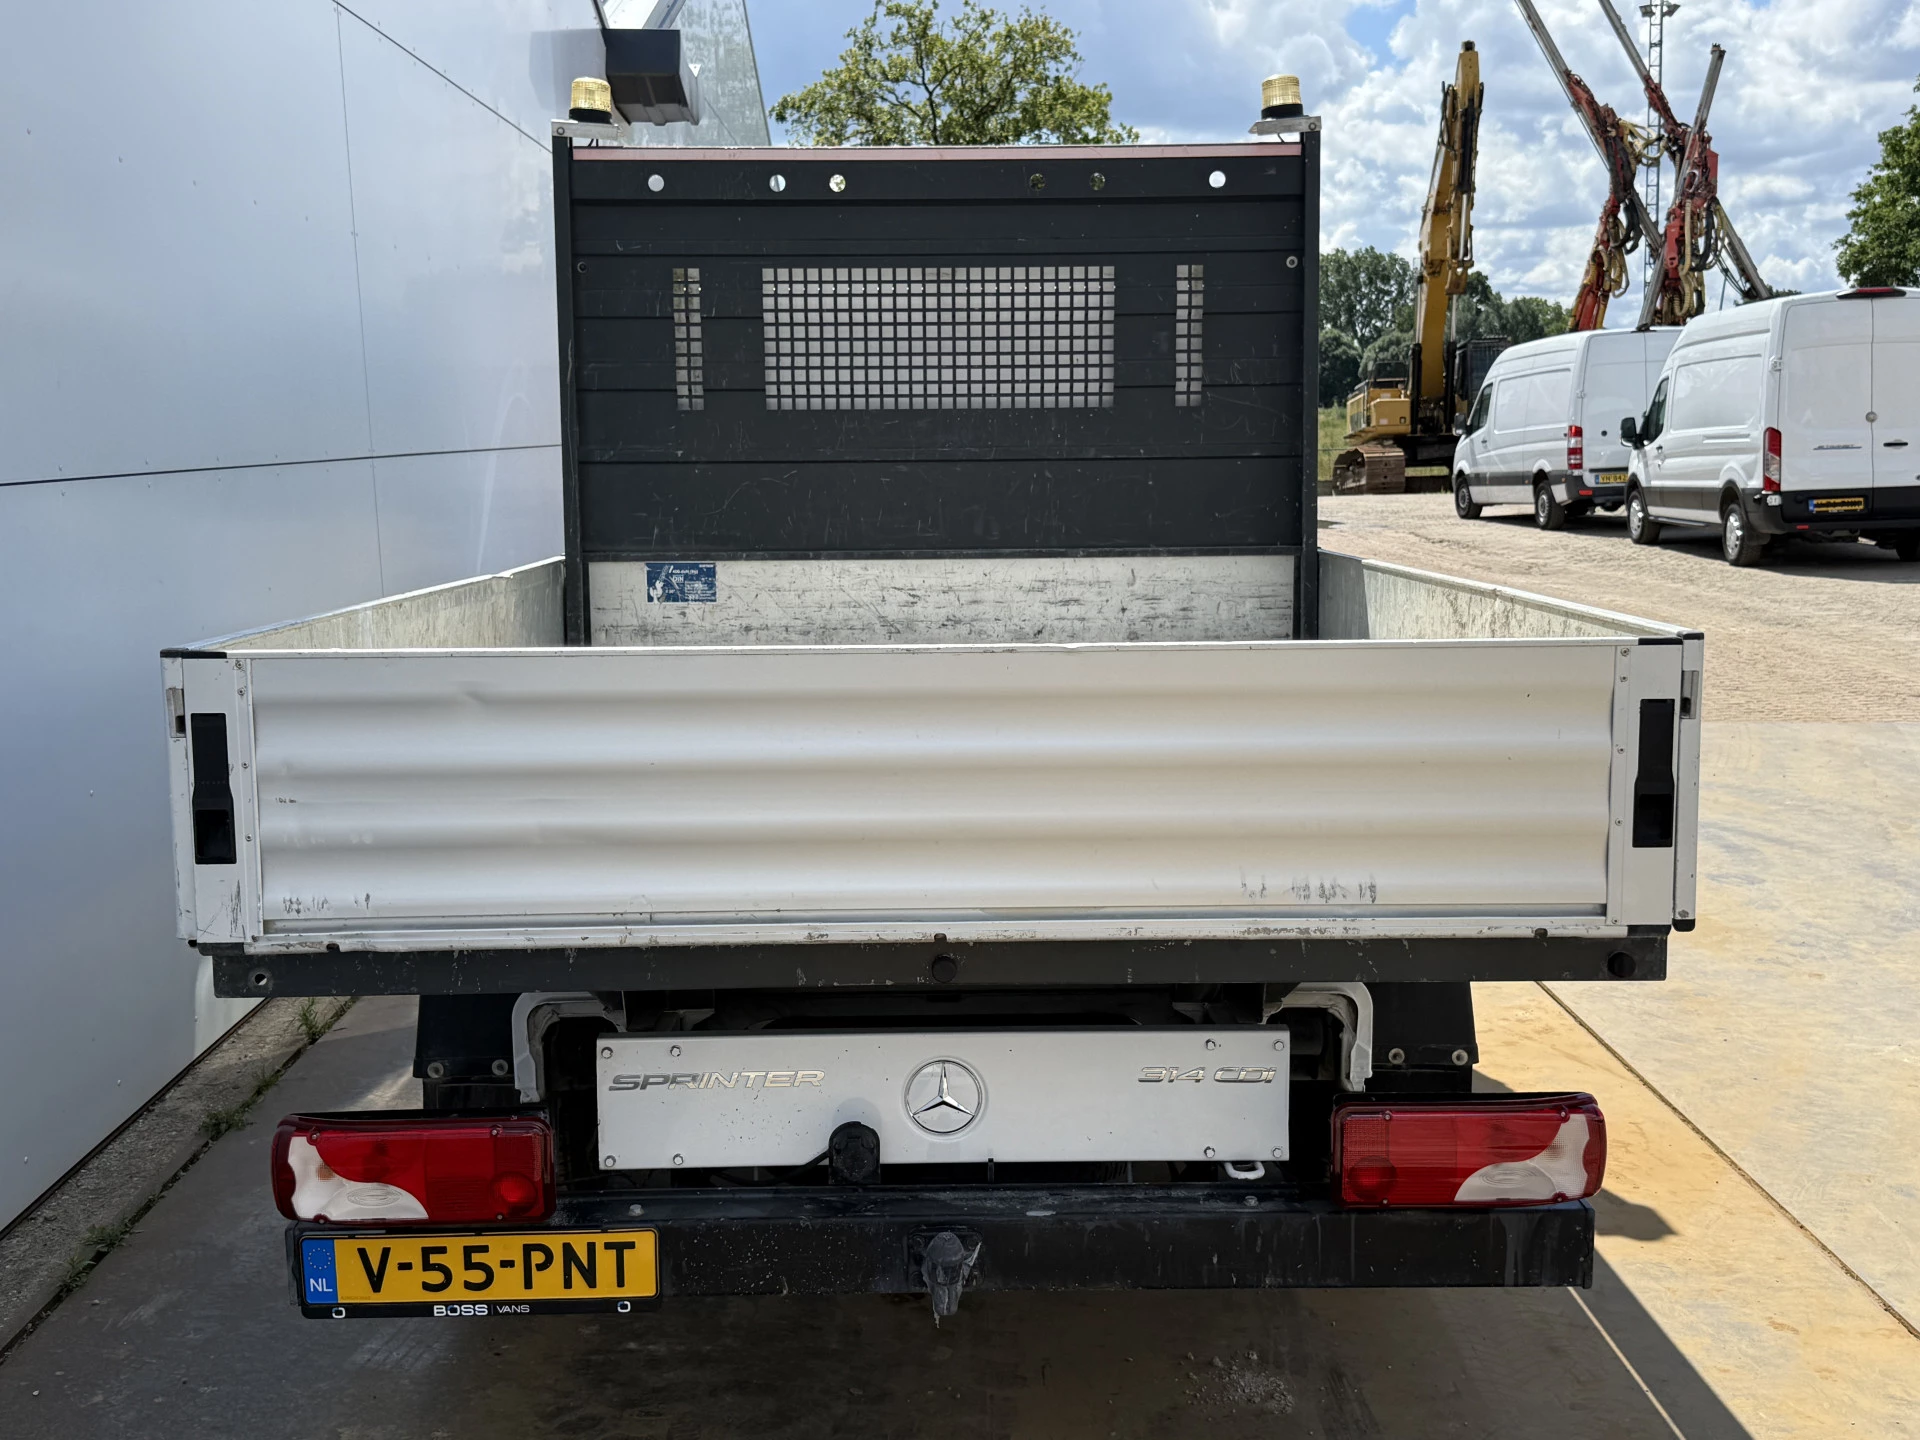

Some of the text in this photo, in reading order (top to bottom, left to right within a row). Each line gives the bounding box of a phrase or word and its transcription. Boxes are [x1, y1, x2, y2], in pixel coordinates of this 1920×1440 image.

[609, 1070, 825, 1091] SPRINTER
[1138, 1066, 1206, 1083] 314
[357, 1241, 636, 1293] V-55-PNT
[310, 1278, 333, 1293] NL
[433, 1304, 530, 1316] BOSS VANS
